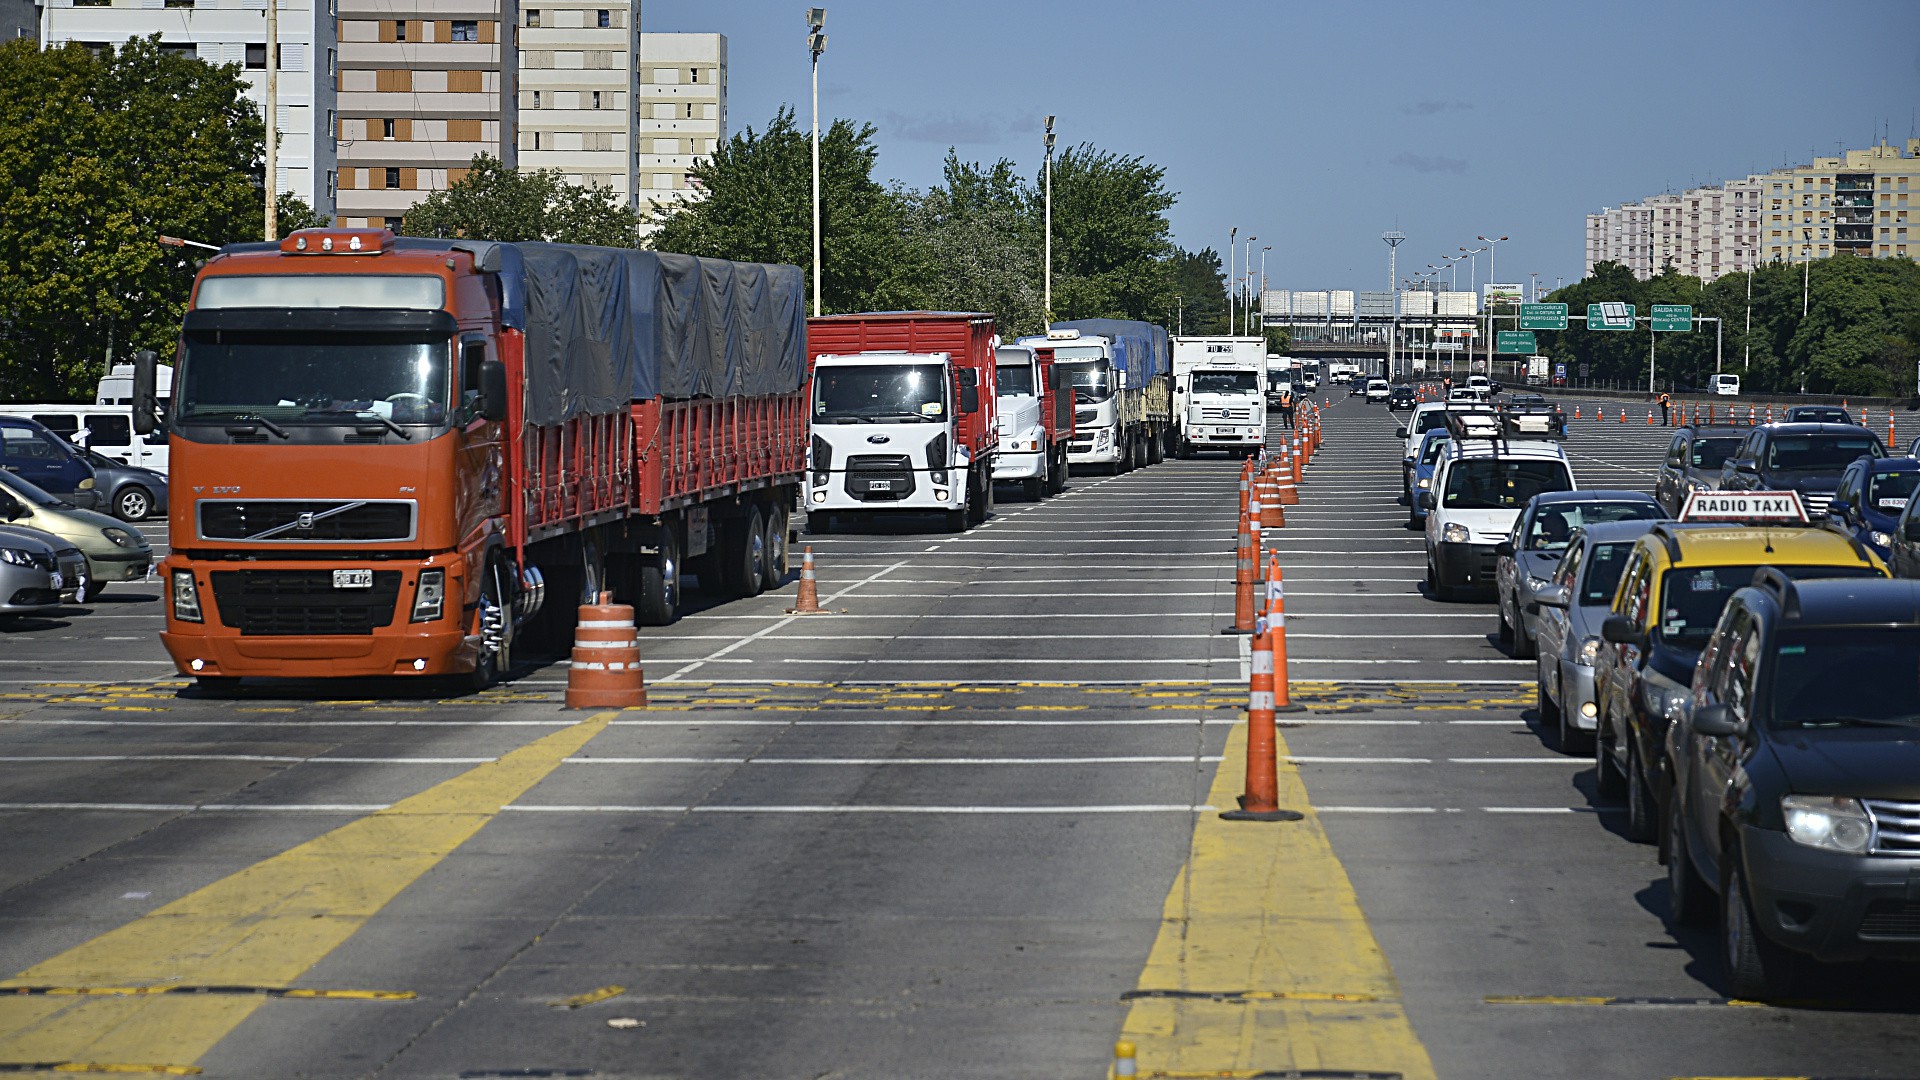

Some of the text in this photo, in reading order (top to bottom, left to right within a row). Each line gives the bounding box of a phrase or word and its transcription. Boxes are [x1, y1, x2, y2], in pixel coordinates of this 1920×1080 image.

[1697, 499, 1789, 512] RADIO TAXI
[354, 574, 370, 584] 472
[1691, 579, 1713, 591] LIBRE
